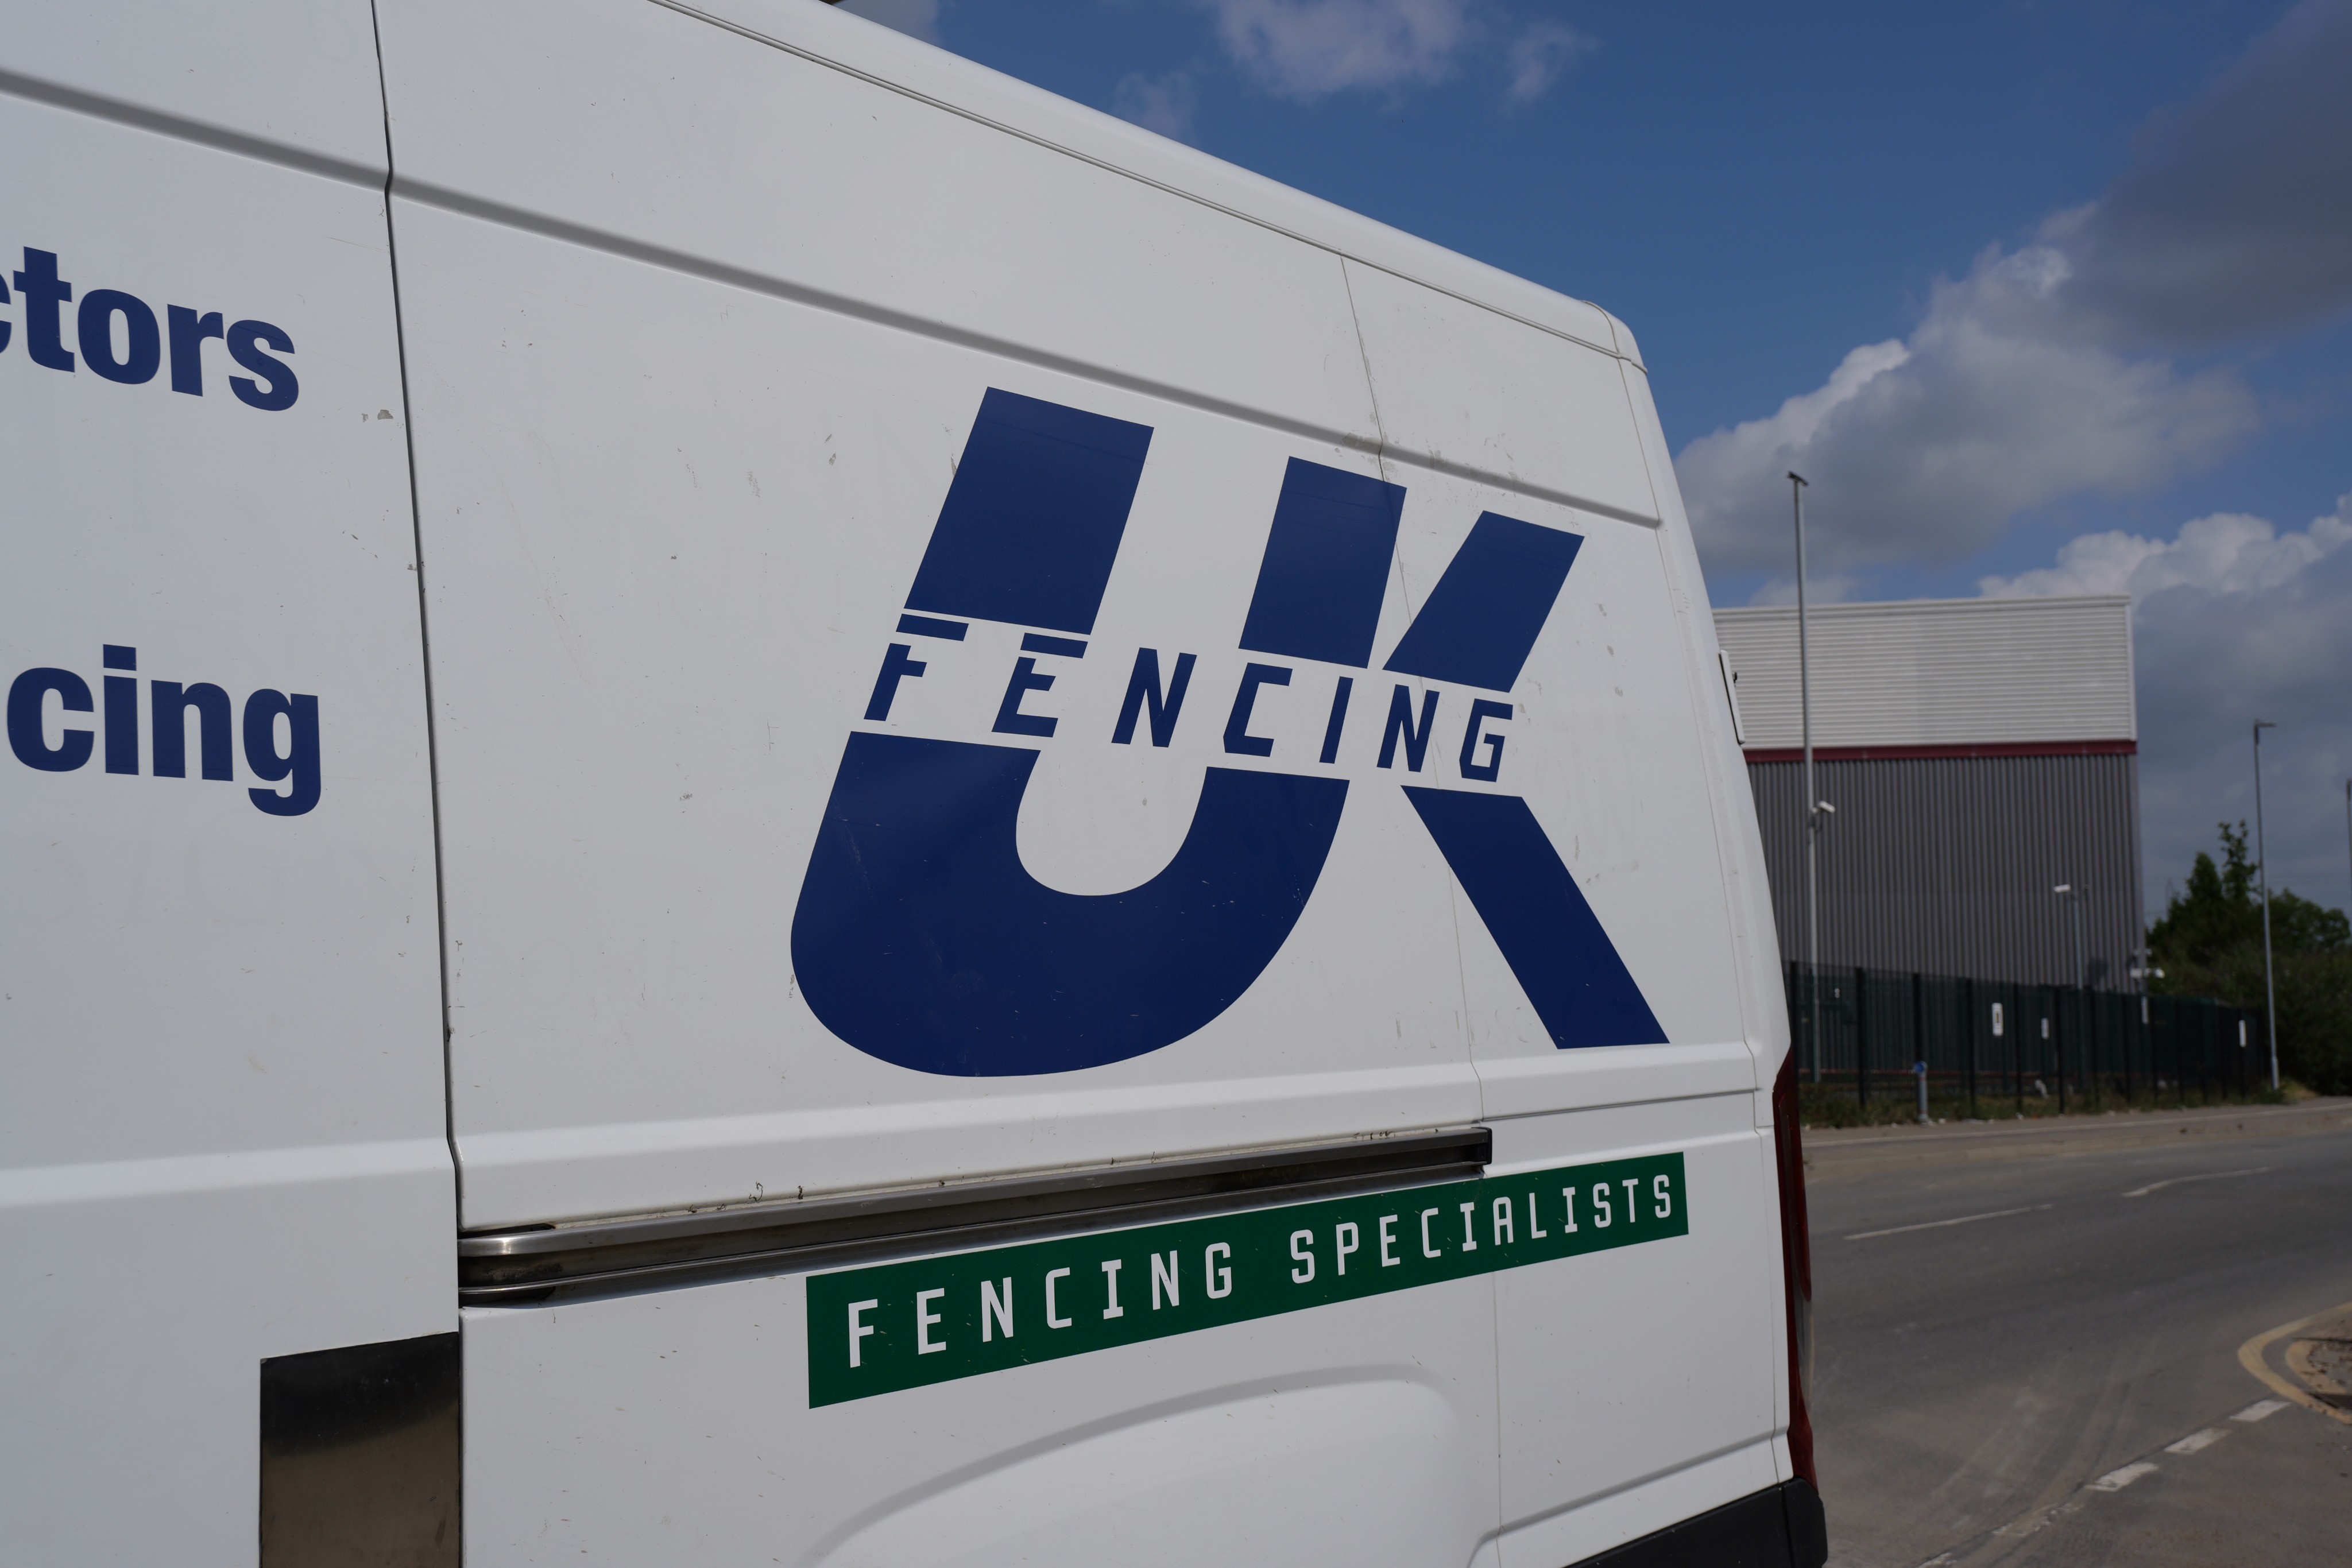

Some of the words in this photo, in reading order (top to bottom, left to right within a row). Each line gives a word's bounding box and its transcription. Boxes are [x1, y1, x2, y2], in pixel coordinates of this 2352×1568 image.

[0, 247, 299, 411] tors
[7, 644, 322, 816] cing
[791, 388, 1670, 1077] UK
[864, 613, 1514, 782] FENCING
[848, 1242, 1233, 1368] FENCING
[1290, 1174, 1672, 1284] SPECIALISTS
